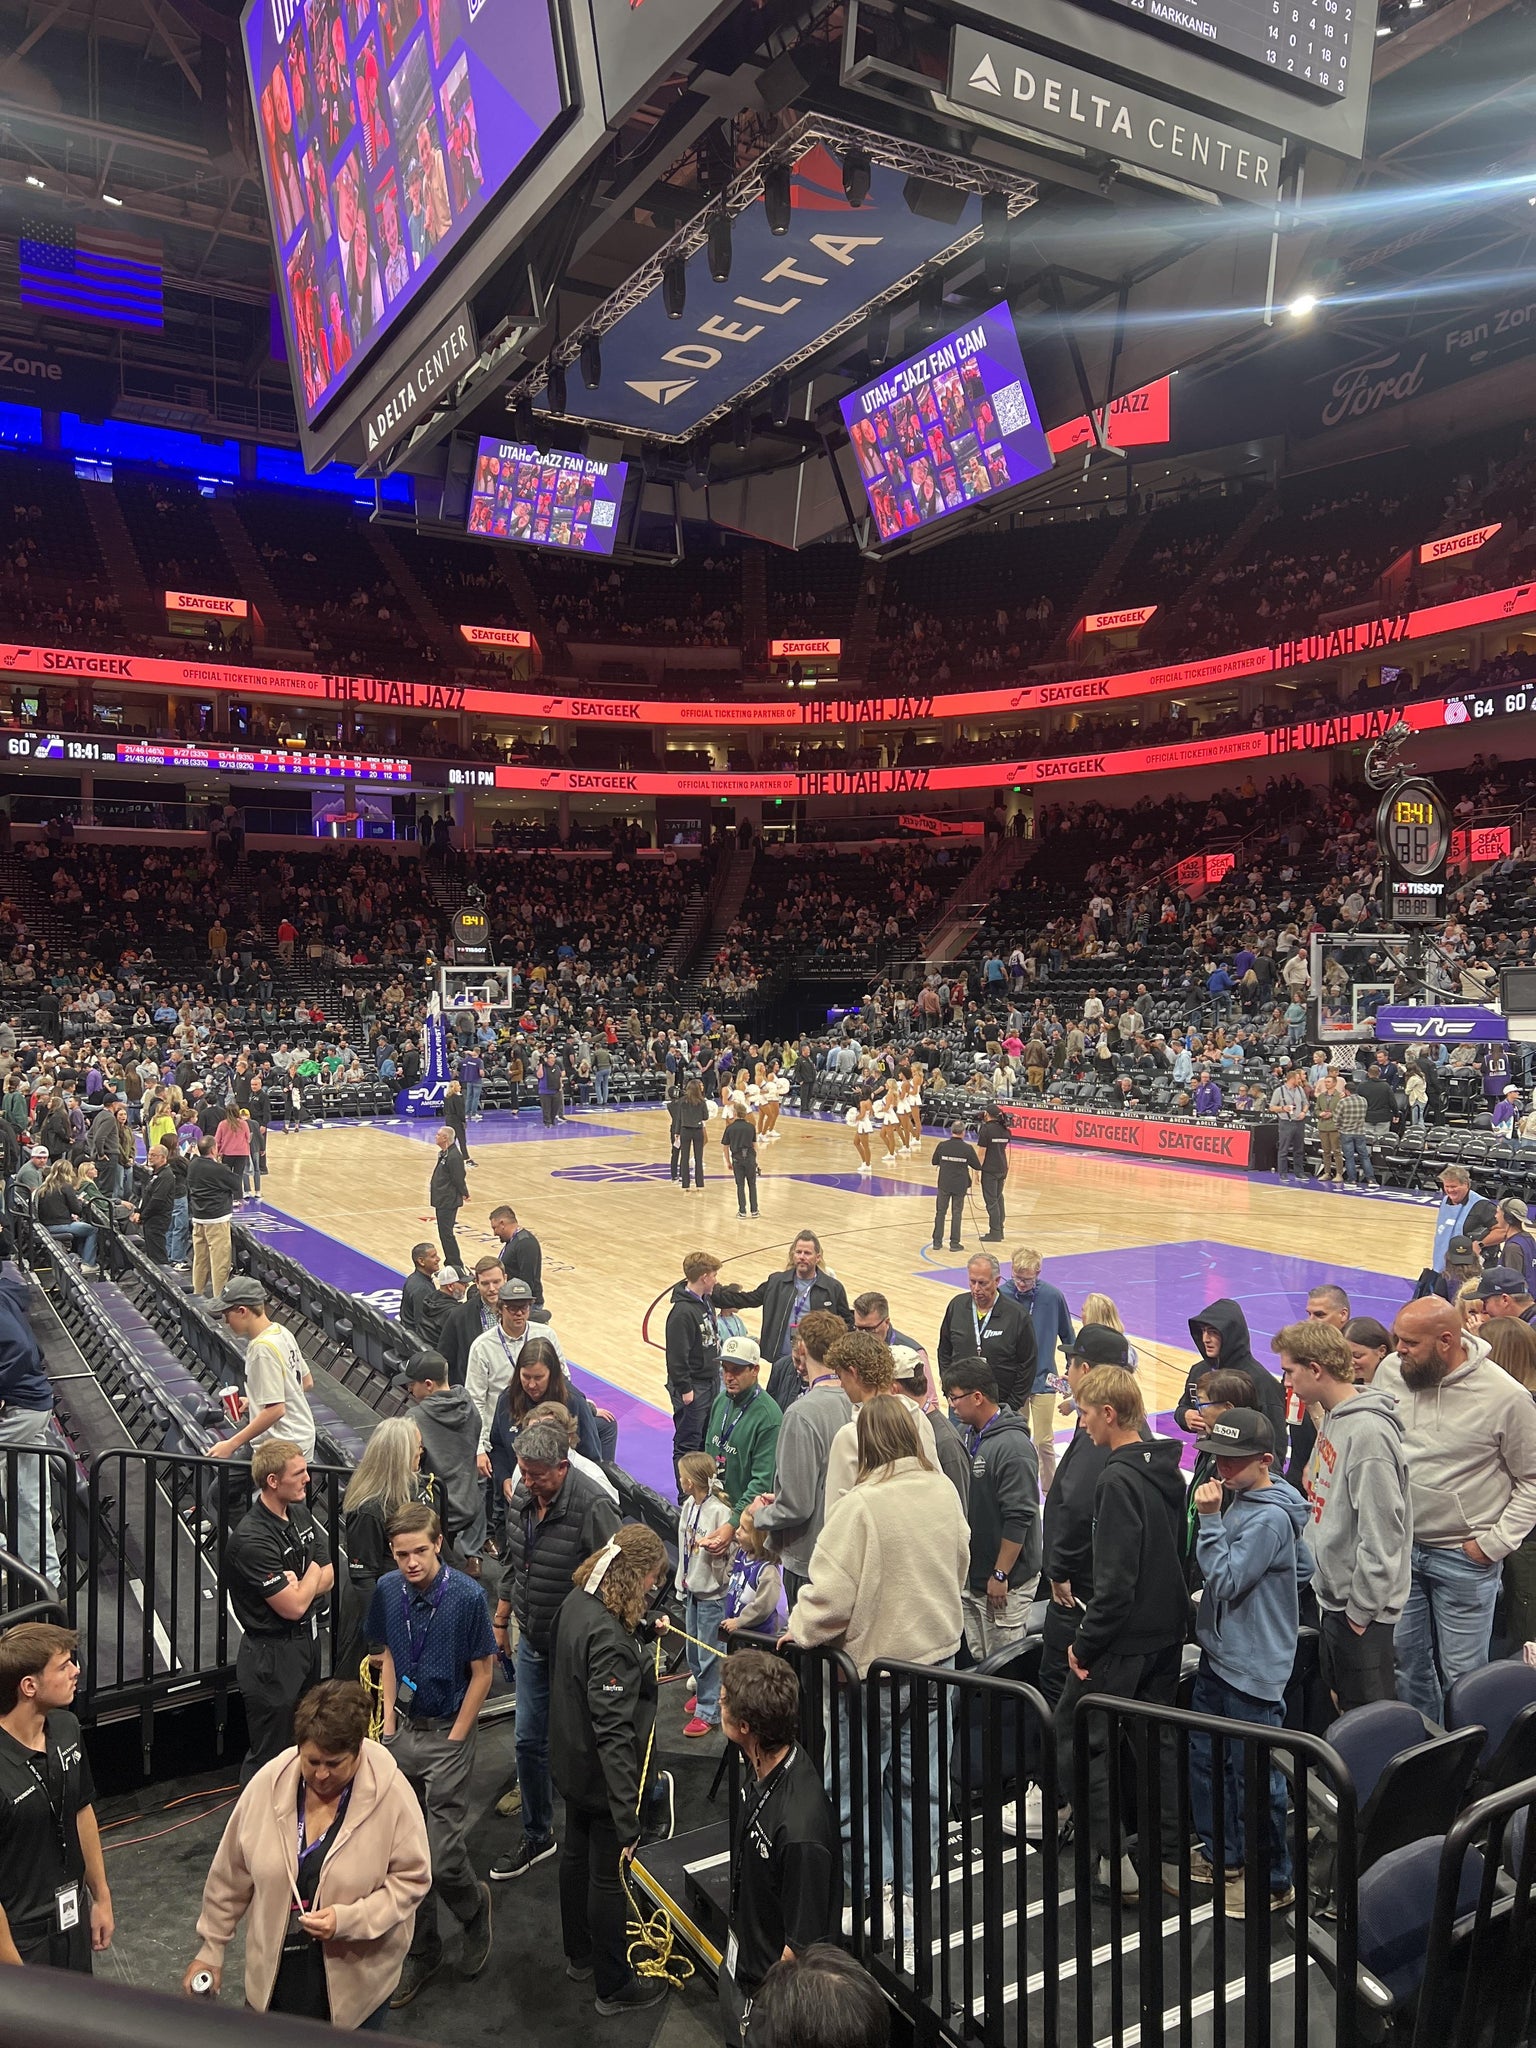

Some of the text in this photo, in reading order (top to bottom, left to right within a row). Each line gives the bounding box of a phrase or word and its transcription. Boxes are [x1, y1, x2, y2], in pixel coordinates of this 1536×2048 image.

[1292, 9, 1299, 22] 8
[1309, 18, 1316, 30] 4
[1324, 24, 1334, 38] 18
[1343, 33, 1349, 45] 1
[1151, 1, 1344, 92] MARKKANEN 13 2 4 18 3
[1268, 25, 1347, 68] 14 0 1 18 0
[1013, 67, 1269, 187] DELTA CENTER
[660, 233, 884, 369] DELTA
[1446, 321, 1489, 354] Fan
[0, 350, 63, 380] Zone
[861, 326, 987, 413] UTAH JAZZ FAN CAM
[377, 325, 468, 437] DELTA CENTER
[1322, 352, 1428, 426] Ford
[1110, 393, 1149, 415] JAZZ
[499, 444, 527, 461] UTAH
[563, 456, 584, 472] FAN
[585, 460, 609, 477] CAM
[1432, 529, 1488, 557] SEATGEEK
[178, 595, 234, 613] SEATGEEK
[1096, 610, 1146, 627] SEATGEEK
[471, 629, 519, 644] SEATGEEK
[782, 641, 830, 653] SEATGEEK
[1150, 613, 1410, 685] OFFICIAL TICKETING PARTNER OF THE UTAH JAZZ
[43, 652, 133, 678] SEATGEEK
[183, 669, 465, 710] OFFICIAL TICKETING PARTNER OF THE UTAH JAZZ
[1040, 680, 1110, 704] SEATGEEK
[571, 701, 641, 719] SEATGEEK
[680, 696, 934, 724] OFFICIAL TICKETING PARTNER OF THE UTAH JAZZ
[1474, 693, 1526, 718] 64 60
[8, 738, 116, 761] 60 13:41 3RD
[1146, 753, 1179, 764] OFFICIAL
[1180, 747, 1218, 760] TICKETING
[1219, 742, 1250, 755] PARTNER
[1252, 740, 1262, 749] OF
[1264, 727, 1301, 756] THE
[1303, 717, 1348, 749] UTAH
[449, 769, 494, 786] 08:11 PM
[1036, 757, 1106, 778] SEATGEEK
[568, 774, 638, 791] SEATGEEK
[678, 769, 930, 795] OFFICIAL TICKETING PARTNER OF THE UTAH JAZZ
[1397, 802, 1433, 825] 13:41
[1477, 843, 1504, 855] GEEK
[1478, 833, 1503, 843] SEAT
[1408, 883, 1445, 894] TISSOT
[1010, 1114, 1059, 1136] EATGEEK
[1075, 1119, 1140, 1146] SEATGEEK
[1158, 1129, 1234, 1158] SEATGEEK
